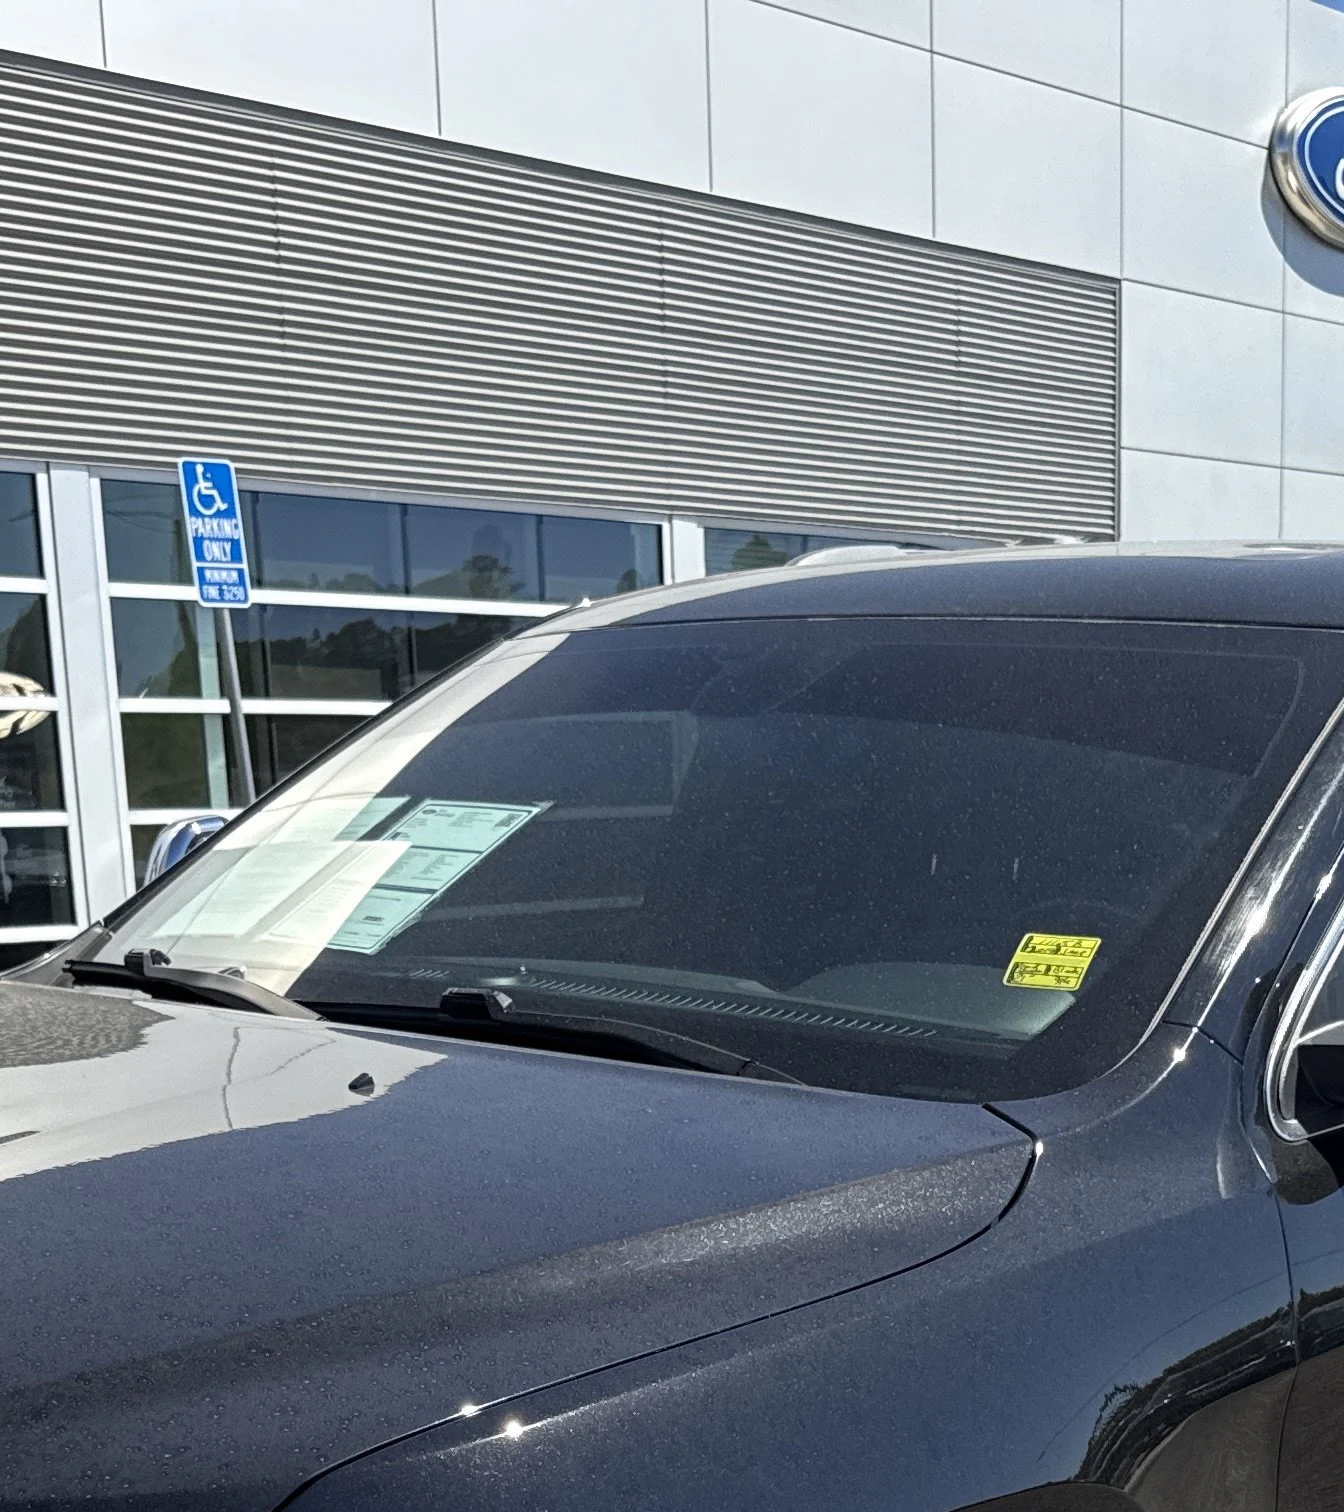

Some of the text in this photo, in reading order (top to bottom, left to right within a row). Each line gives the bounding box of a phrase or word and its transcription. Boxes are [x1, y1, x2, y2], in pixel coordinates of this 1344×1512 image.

[190, 516, 240, 540] PARKING
[202, 540, 232, 562] ONLY
[203, 569, 240, 584] MINIMUM
